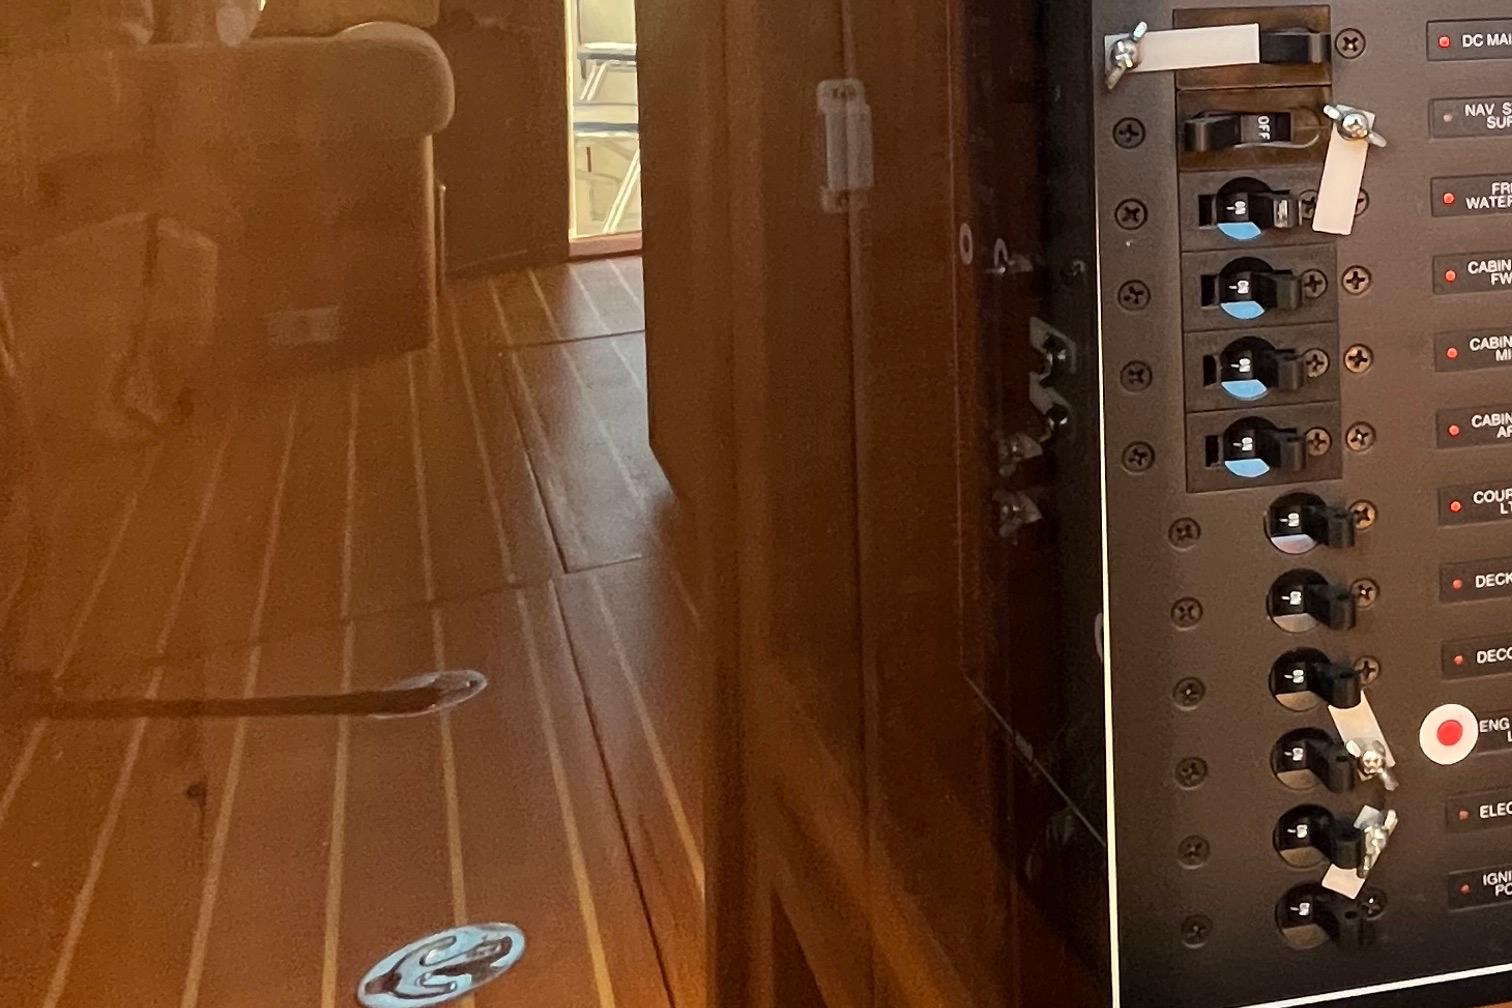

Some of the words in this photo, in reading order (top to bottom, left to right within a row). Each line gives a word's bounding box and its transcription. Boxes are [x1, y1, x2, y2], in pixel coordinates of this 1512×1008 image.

[1462, 34, 1483, 48] DC
[1465, 104, 1495, 117] NAV
[1257, 115, 1271, 140] OFF
[1467, 259, 1512, 275] CABIN
[1469, 336, 1512, 351] CABIN
[1479, 718, 1510, 733] ENG
